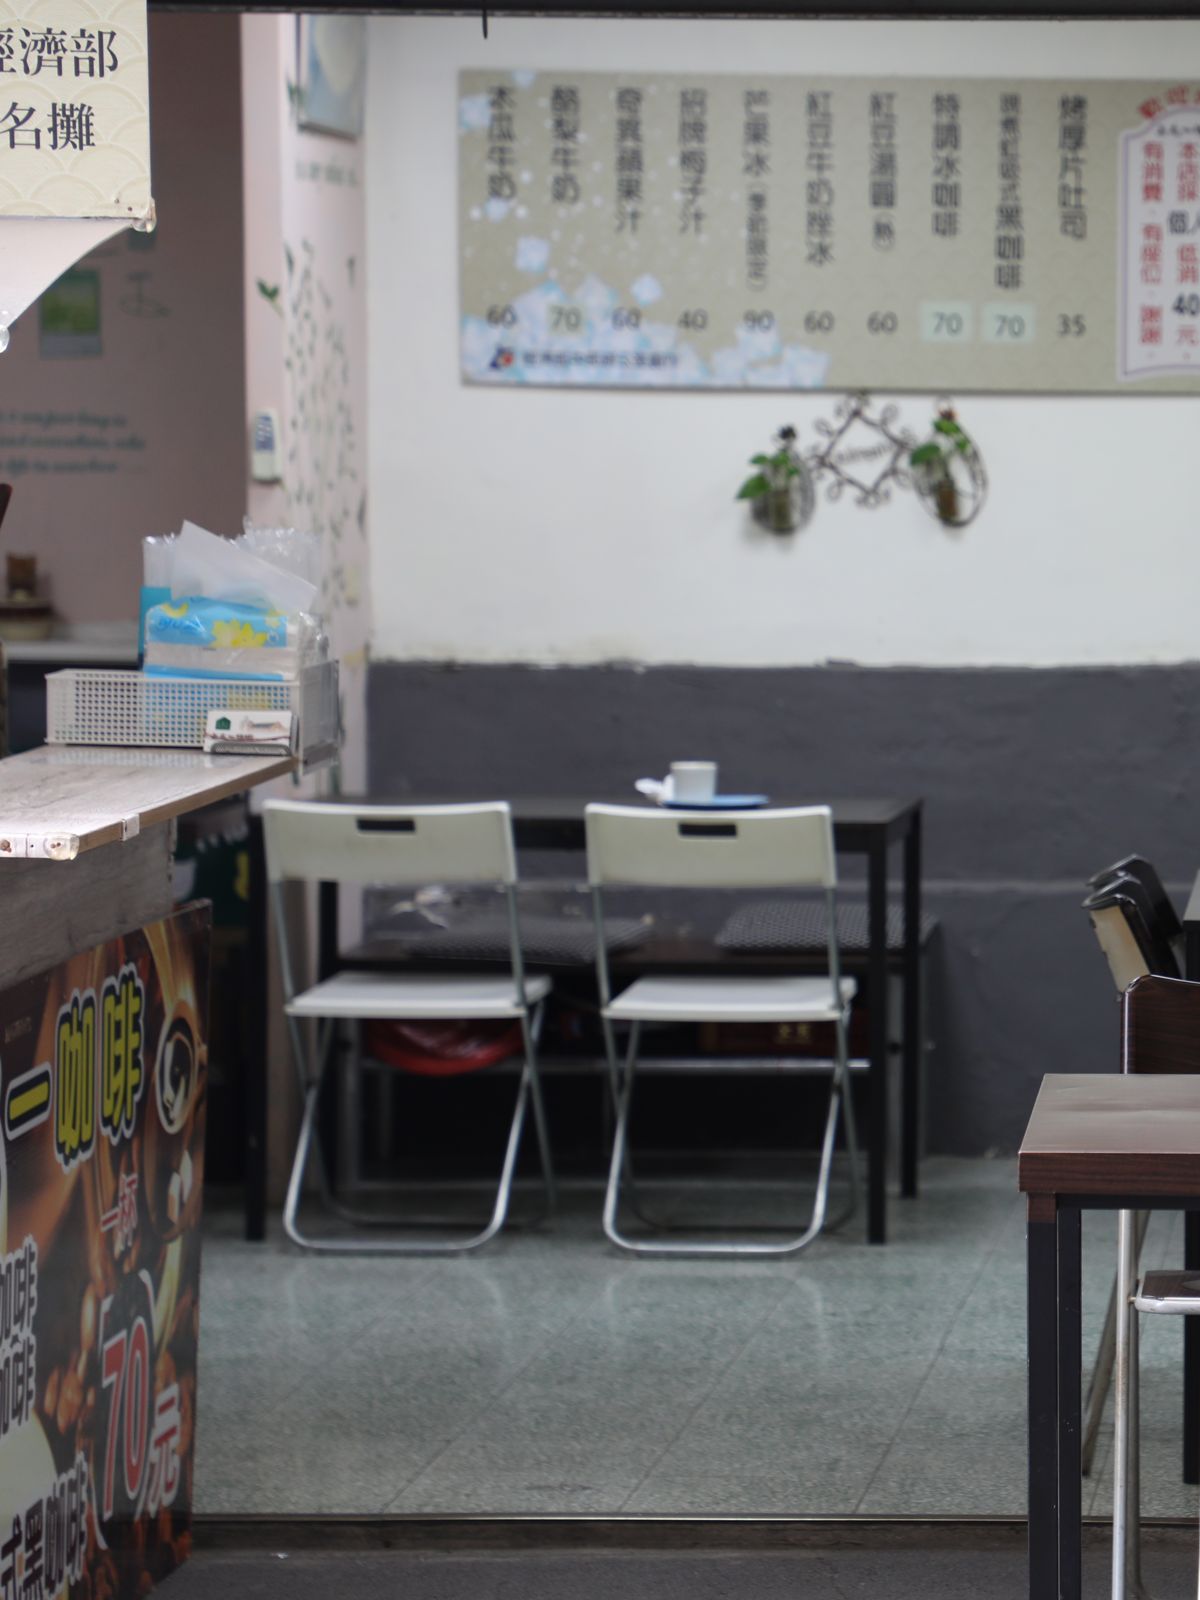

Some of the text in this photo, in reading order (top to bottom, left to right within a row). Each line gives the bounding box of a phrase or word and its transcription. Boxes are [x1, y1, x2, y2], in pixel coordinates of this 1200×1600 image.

[0, 102, 96, 151] 名攤
[486, 86, 517, 200] 木瓜牛奶
[550, 86, 581, 203] 酪梨牛奶
[931, 93, 962, 238] 特調冰咖啡
[1056, 95, 1088, 241] 烤厚片吐司
[486, 304, 517, 329] 60
[551, 307, 581, 330] 70
[612, 306, 641, 330] 60
[678, 309, 709, 331] 40
[744, 310, 775, 332] 90
[804, 311, 835, 333] 60
[867, 312, 898, 335] 60
[932, 313, 963, 335] 70
[995, 315, 1026, 338] 70
[1057, 315, 1086, 337] 35
